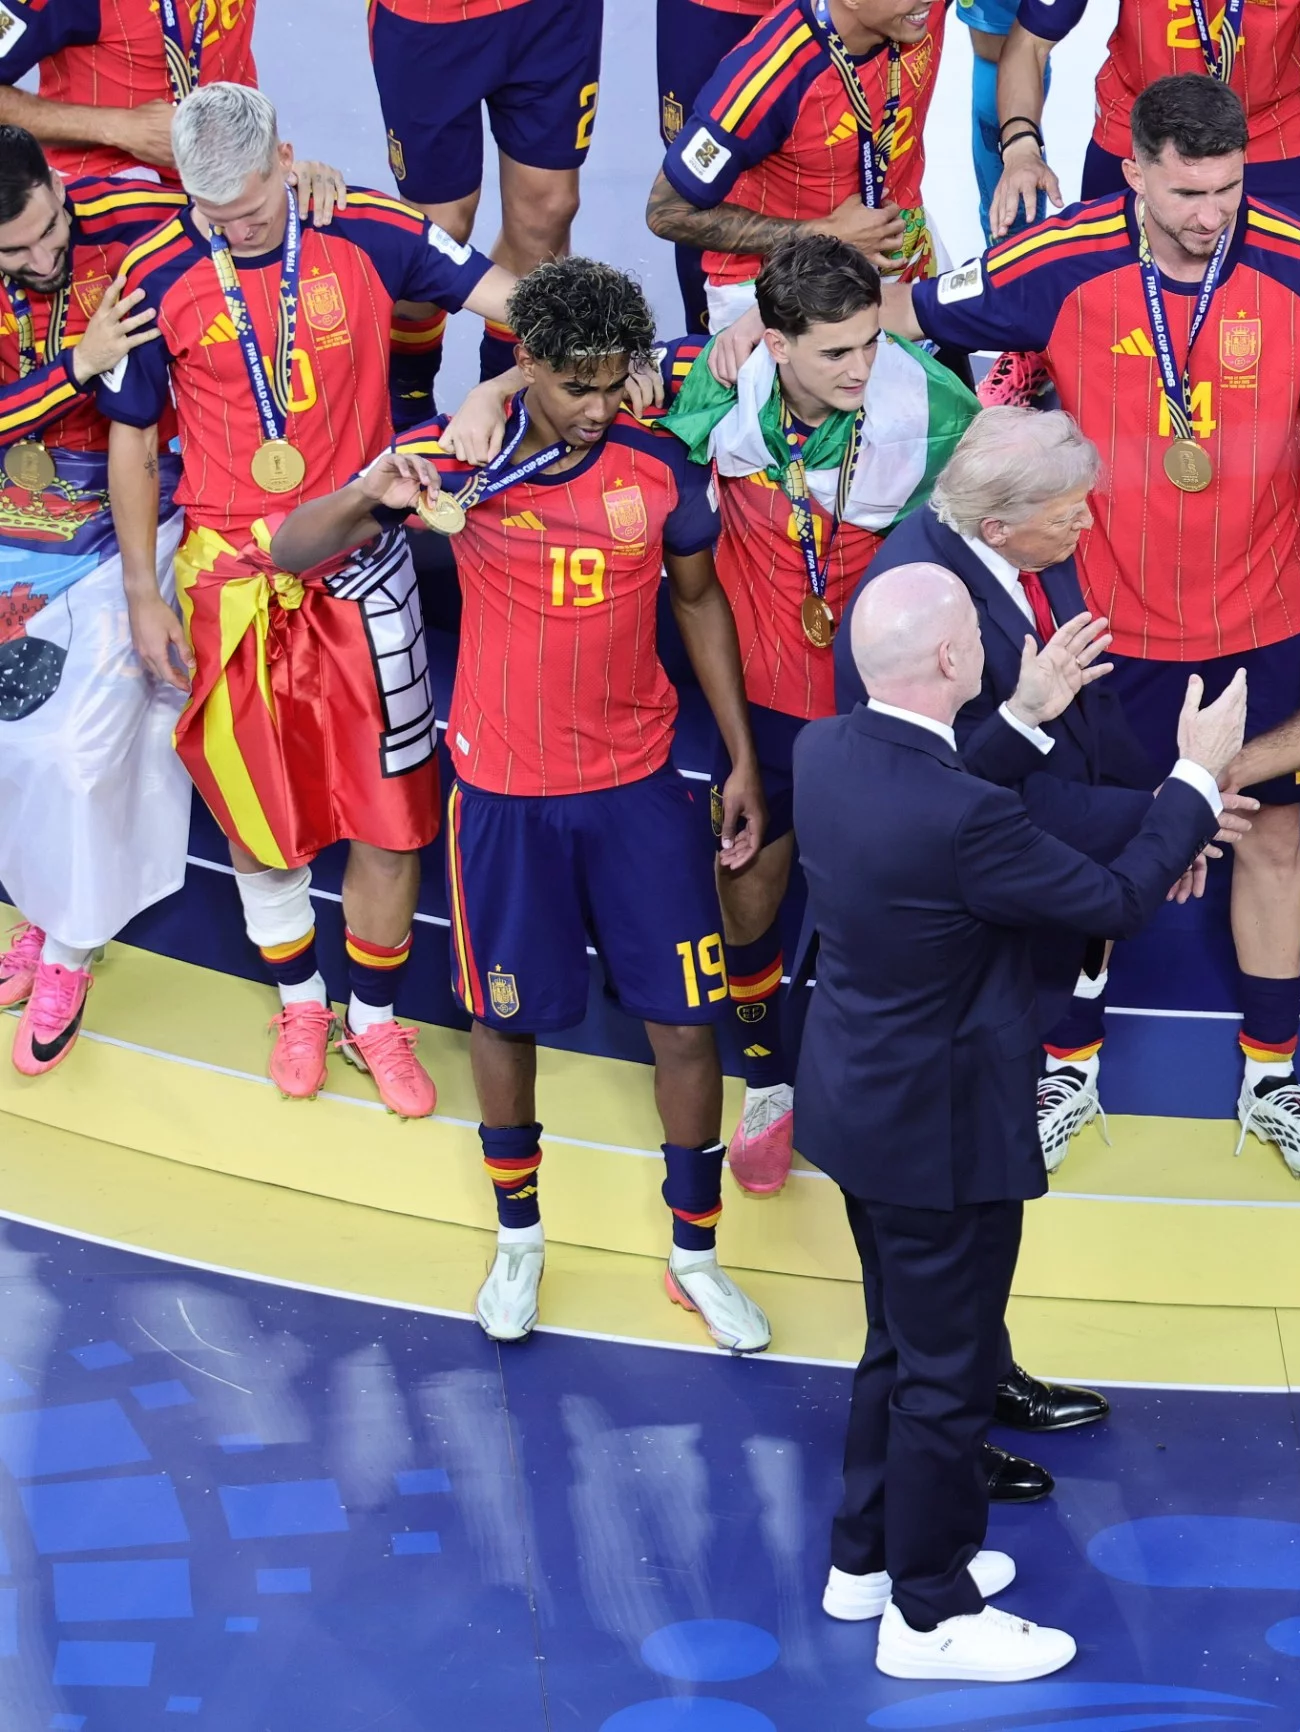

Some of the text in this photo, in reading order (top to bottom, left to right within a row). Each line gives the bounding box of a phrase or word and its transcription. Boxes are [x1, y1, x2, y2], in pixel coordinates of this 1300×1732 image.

[862, 141, 875, 209] ORLD CUP 2026
[286, 213, 297, 250] WORLD
[1214, 234, 1226, 257] FIFA
[285, 251, 296, 273] FIFA
[1203, 256, 1220, 293] WORLD
[1198, 292, 1210, 314] CUP
[1146, 275, 1176, 388] FIFA WORLD CUP 2026
[245, 341, 279, 439] FIFA WORLD CUP 20
[487, 447, 560, 493] FIFA WORLD CUP 2026
[550, 547, 606, 607] 19
[806, 549, 820, 596] FIFA WOR
[676, 932, 728, 1008] 19
[940, 1638, 953, 1652] FIFA
